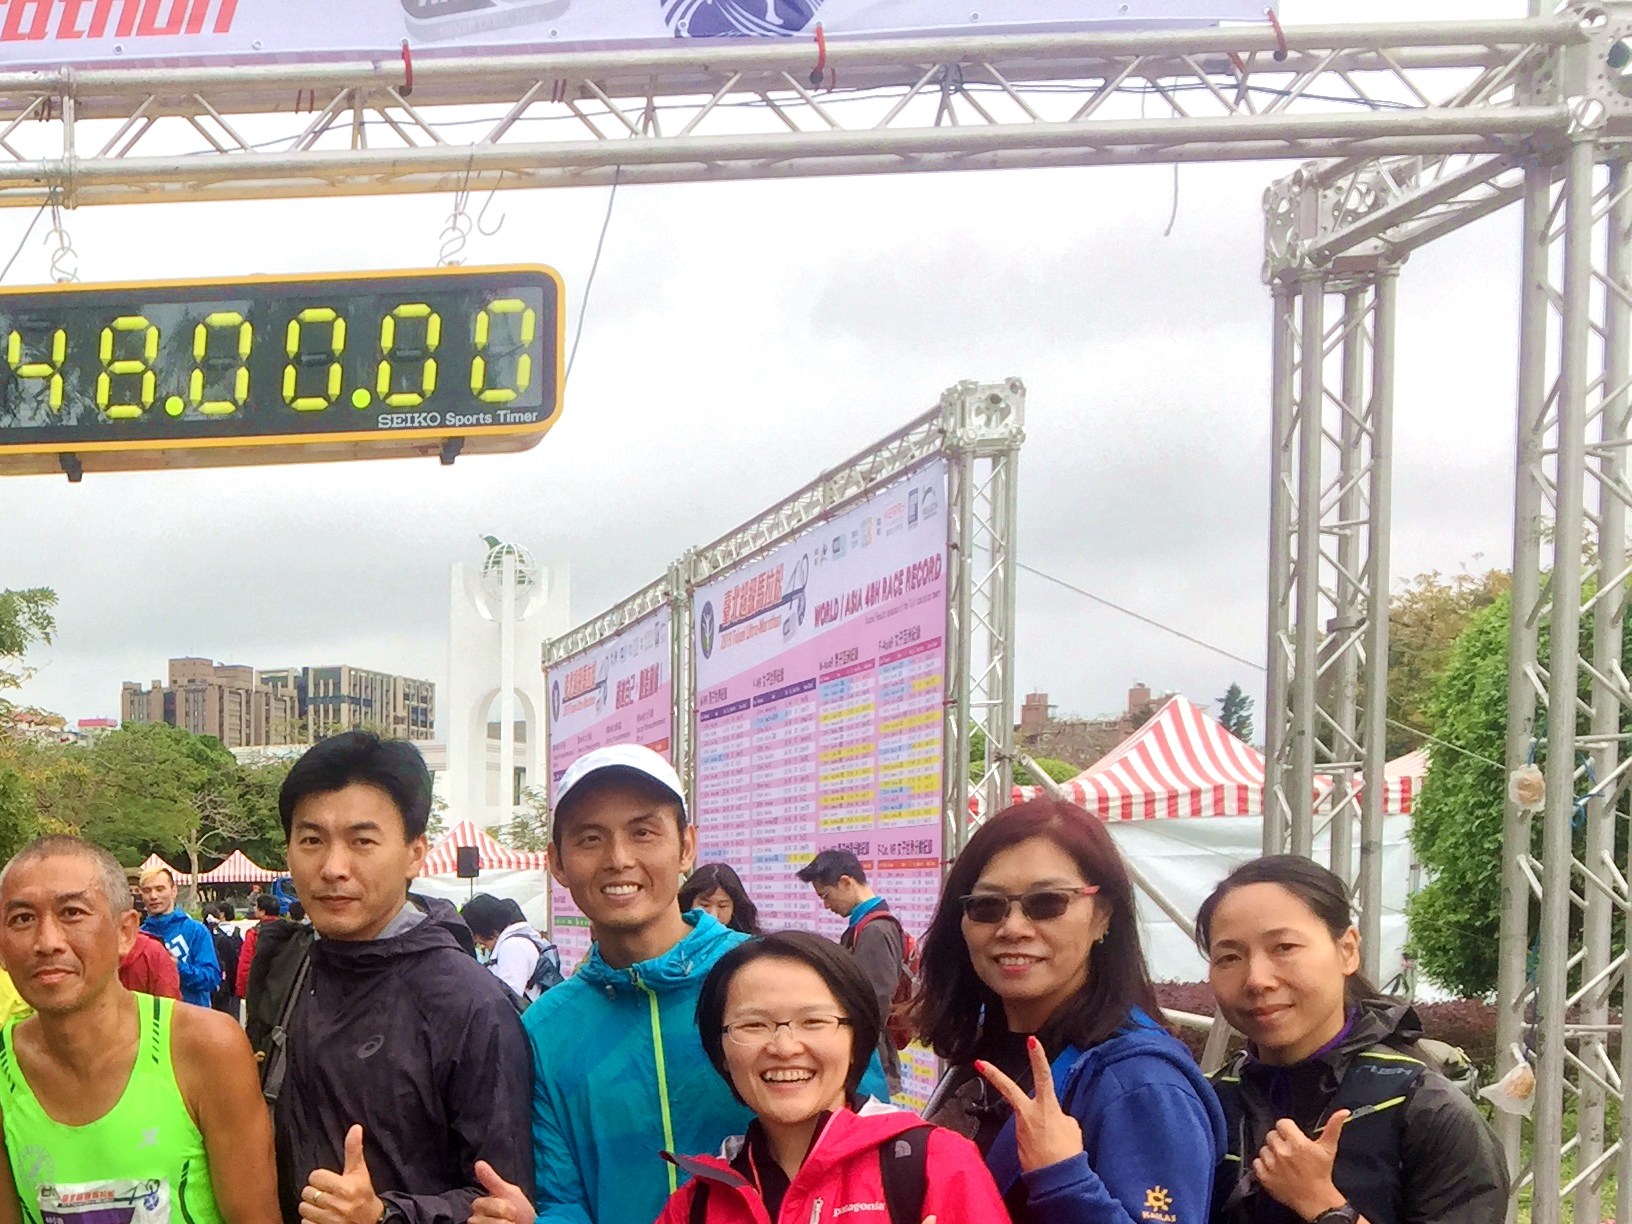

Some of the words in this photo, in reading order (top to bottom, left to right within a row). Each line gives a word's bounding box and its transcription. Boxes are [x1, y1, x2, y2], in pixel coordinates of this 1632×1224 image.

[378, 412, 441, 428] SEIKO
[445, 413, 493, 427] Sports
[496, 409, 539, 423] Timer
[881, 568, 905, 602] RACE
[905, 552, 942, 592] RECORD
